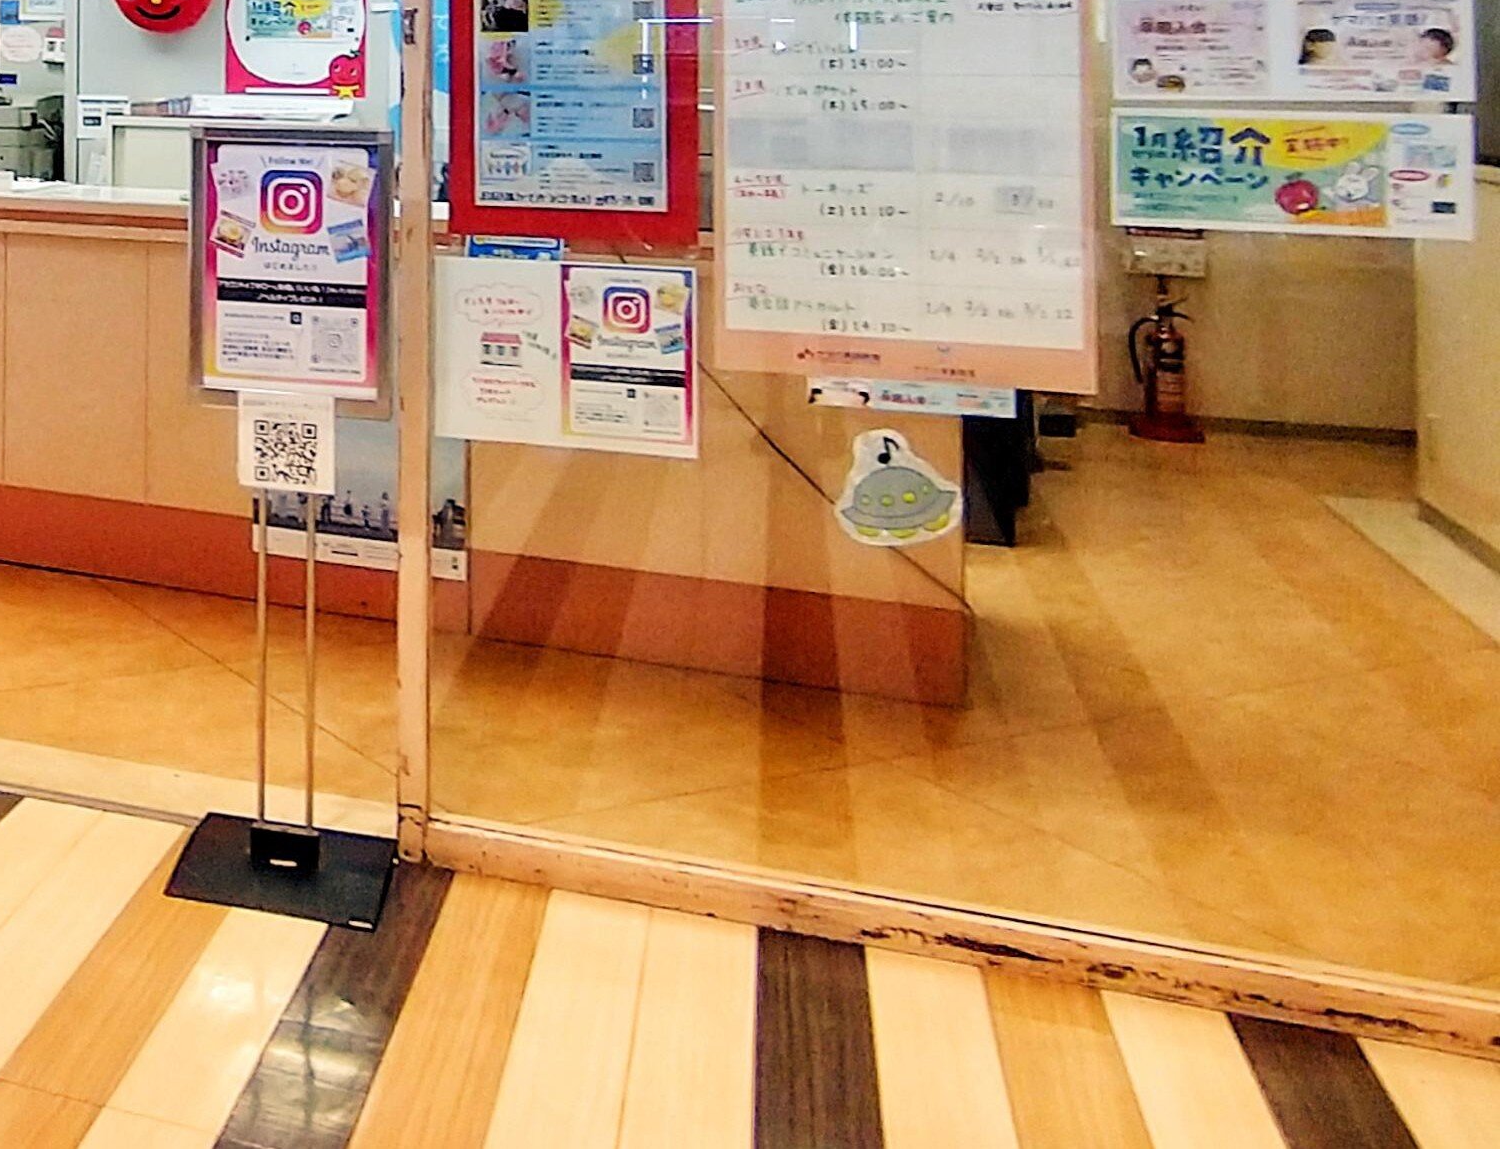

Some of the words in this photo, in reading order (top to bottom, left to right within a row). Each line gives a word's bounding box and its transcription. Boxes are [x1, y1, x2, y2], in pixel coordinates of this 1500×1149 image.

[1129, 166, 1270, 189] キャンペーン
[250, 235, 331, 262] Instagram
